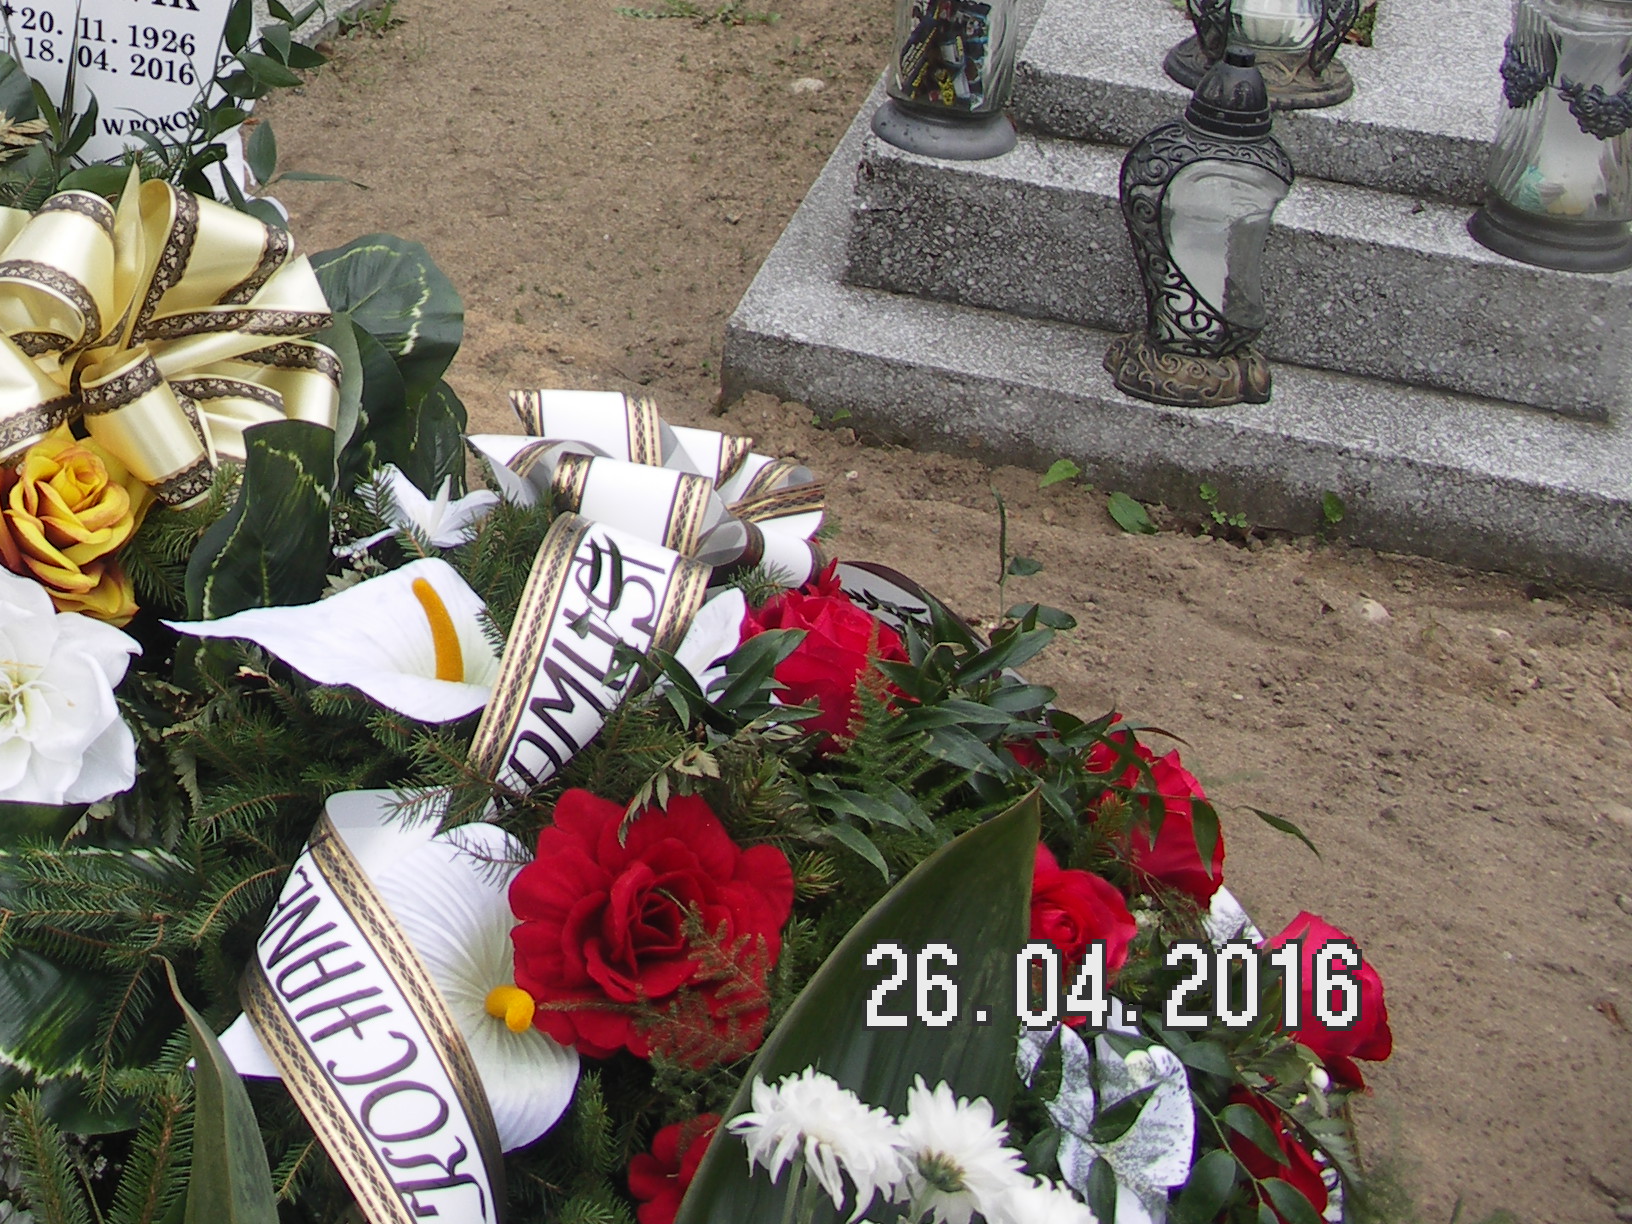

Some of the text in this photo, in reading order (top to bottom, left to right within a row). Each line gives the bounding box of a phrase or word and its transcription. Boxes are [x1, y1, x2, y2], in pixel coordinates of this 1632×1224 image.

[128, 25, 196, 56] 1926
[130, 53, 194, 86] 2016
[258, 831, 488, 1222] KOCHANE
